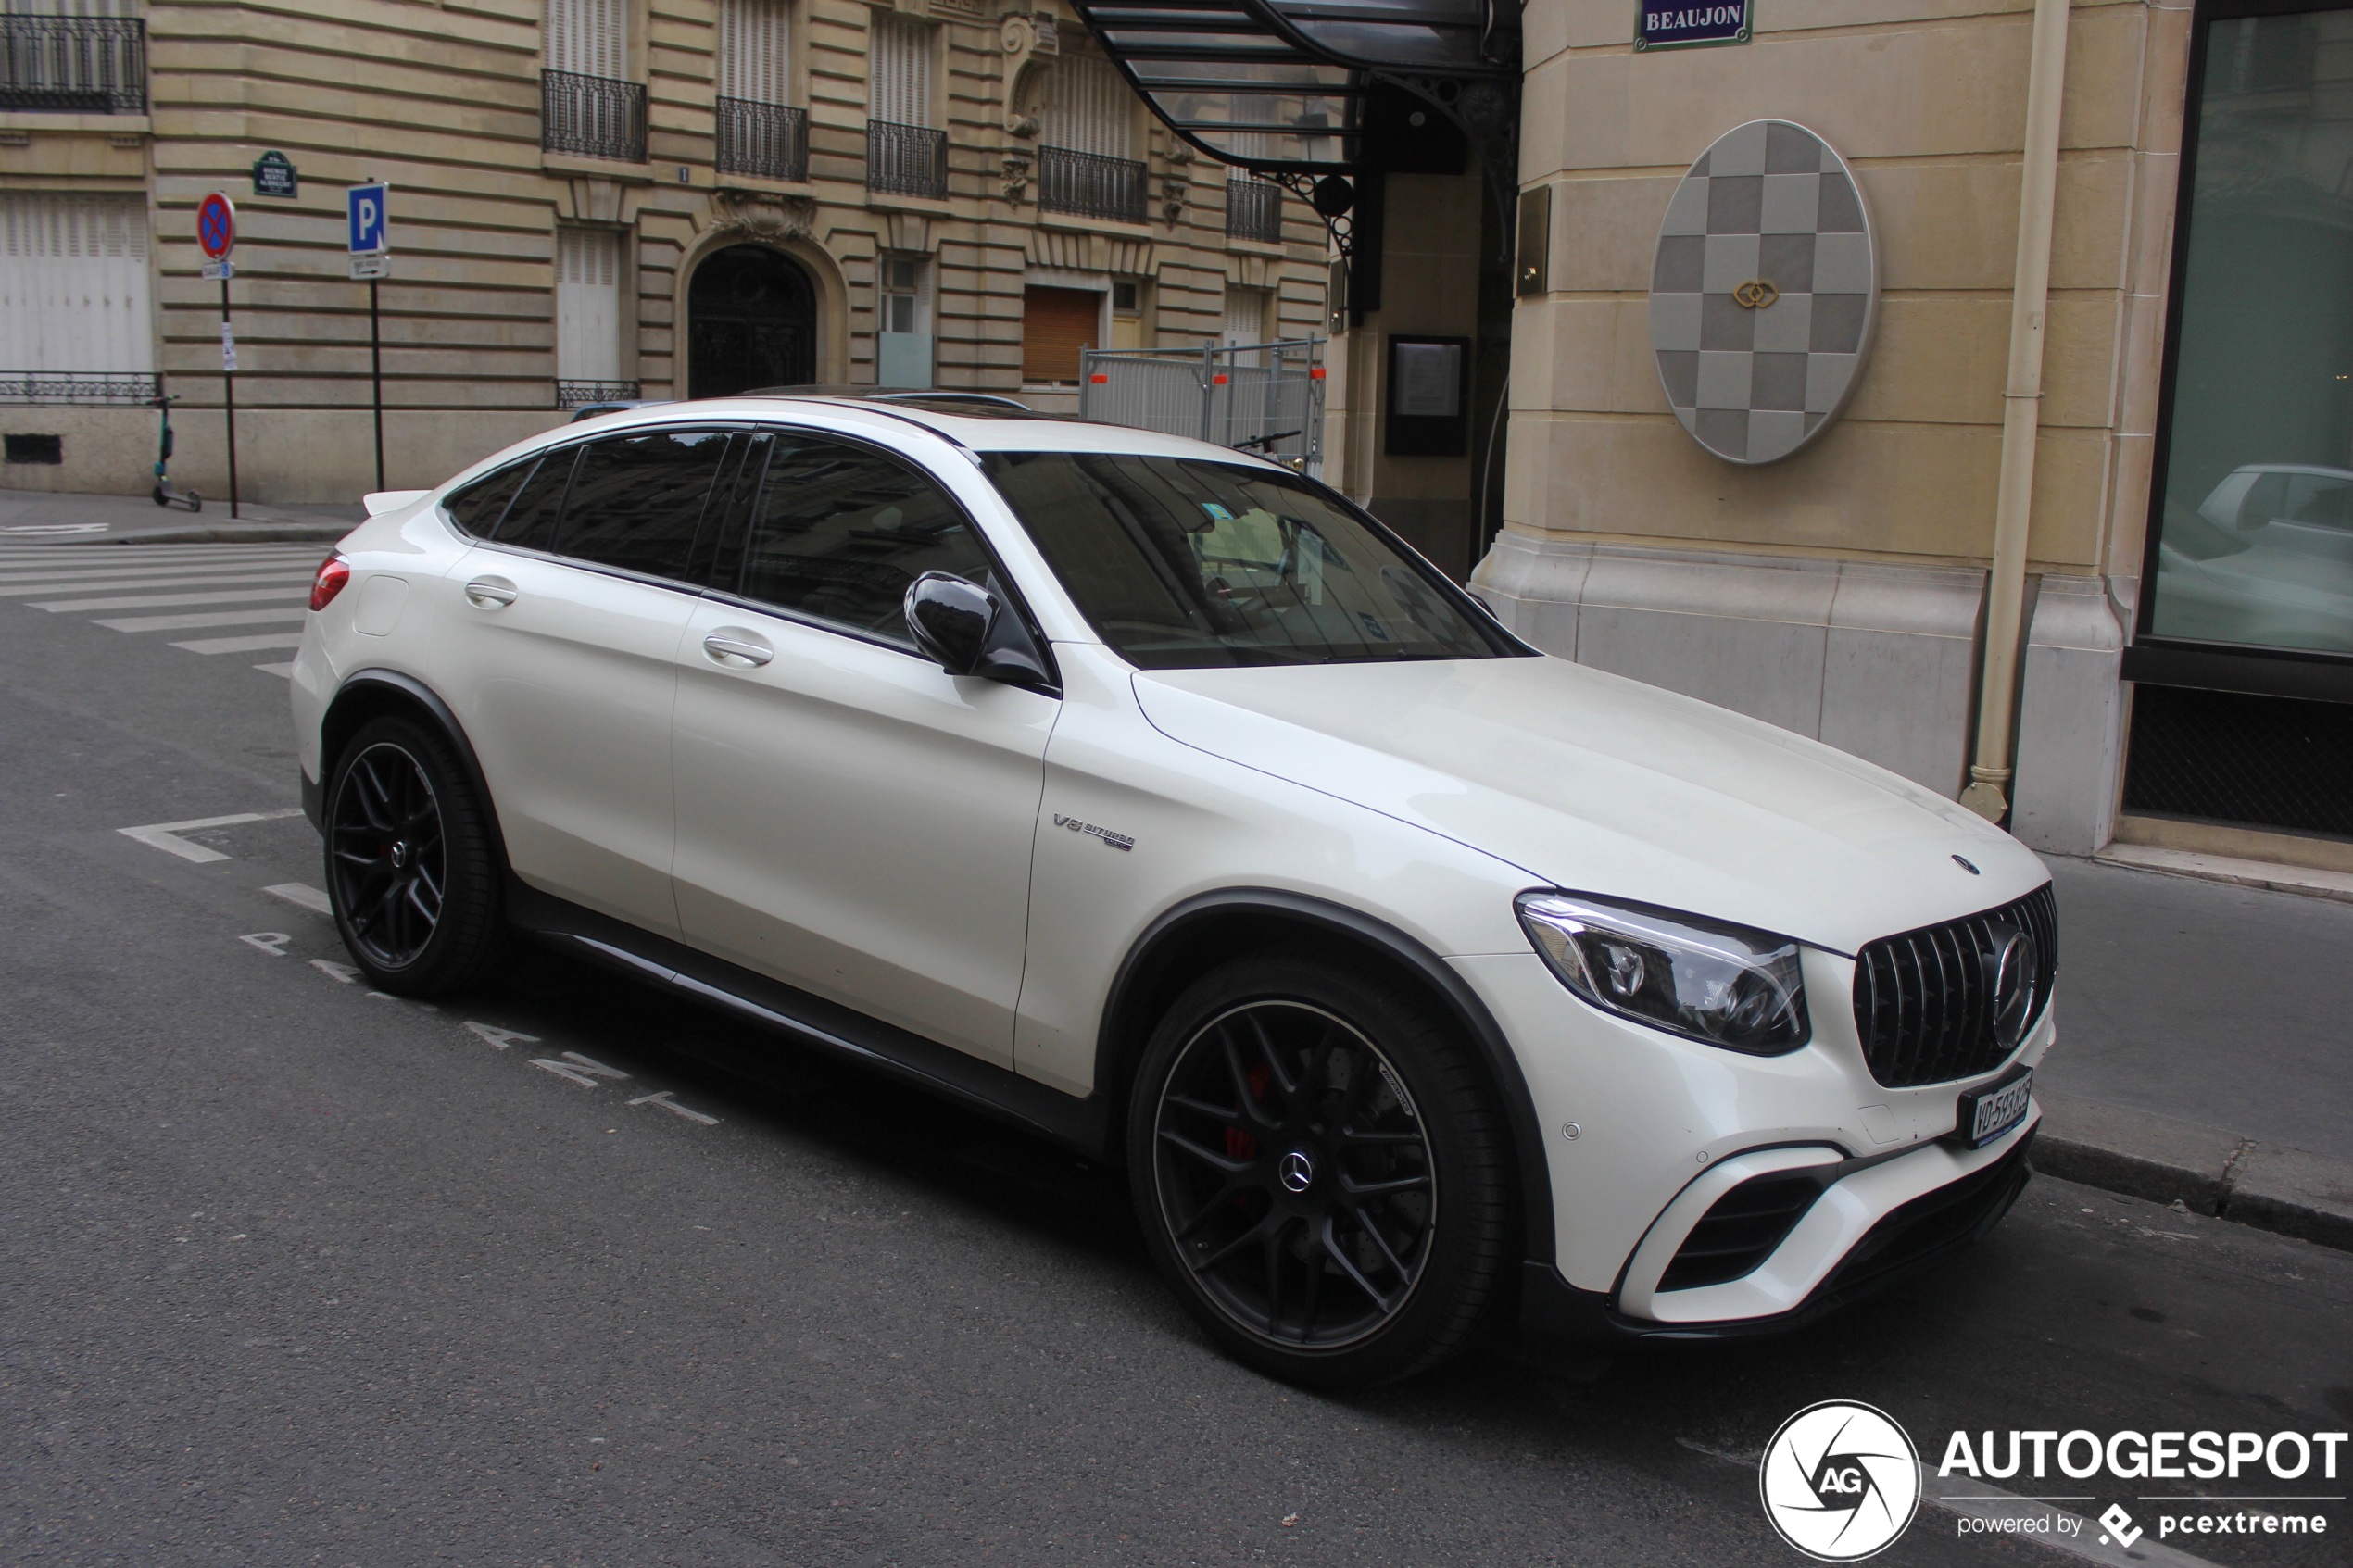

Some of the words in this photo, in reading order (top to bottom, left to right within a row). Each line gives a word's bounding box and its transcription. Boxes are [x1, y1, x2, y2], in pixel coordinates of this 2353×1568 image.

[1646, 6, 1741, 31] BEAUJON
[359, 198, 377, 241] P
[1053, 812, 1083, 832] V8
[1084, 822, 1136, 847] BITURBO
